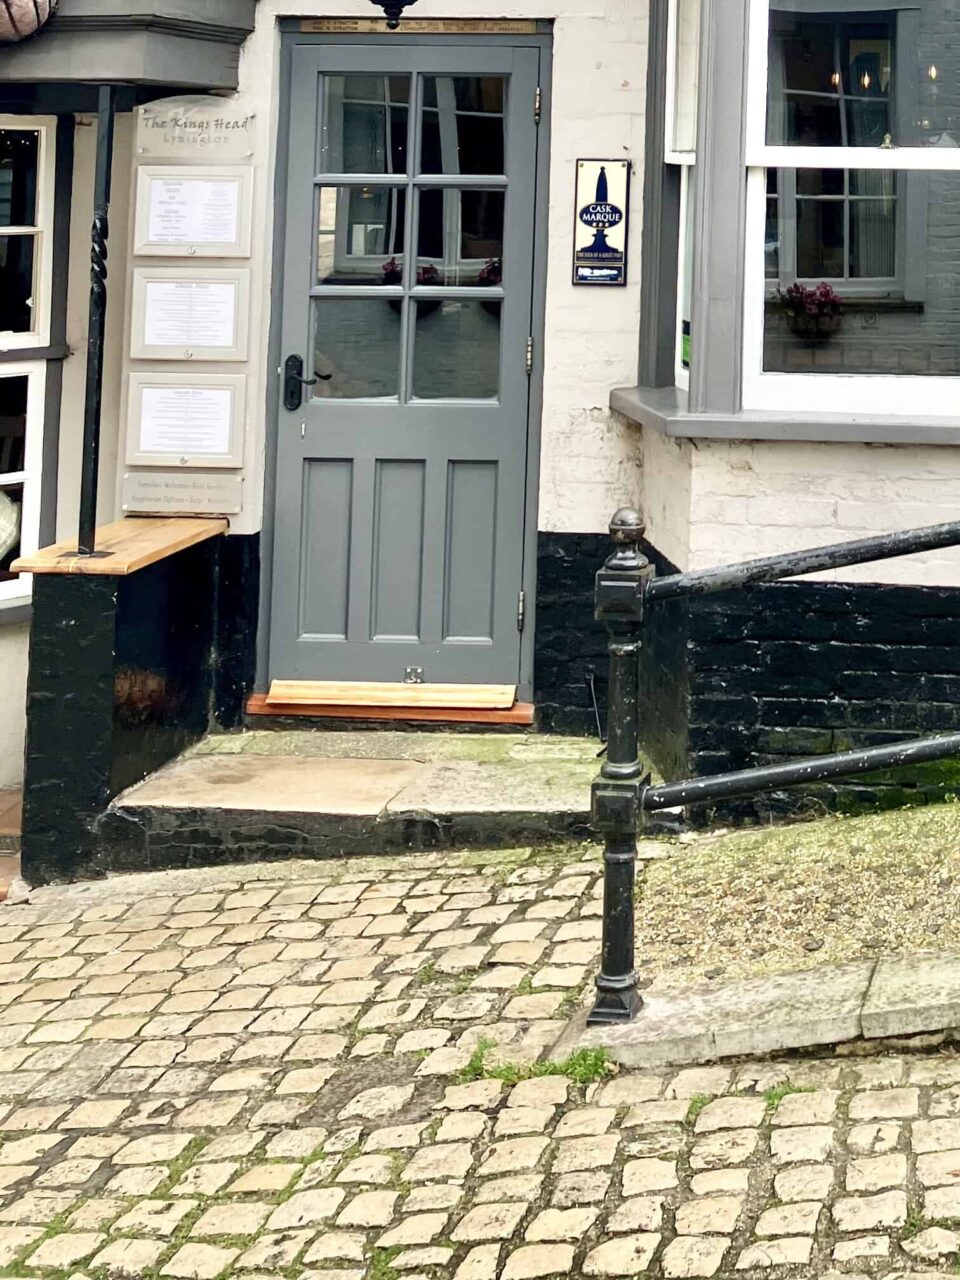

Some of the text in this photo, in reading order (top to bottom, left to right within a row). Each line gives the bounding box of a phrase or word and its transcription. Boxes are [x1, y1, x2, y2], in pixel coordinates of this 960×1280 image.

[143, 117, 249, 136] The Kings Head
[589, 205, 612, 213] CASK
[582, 213, 620, 222] MARQUE
